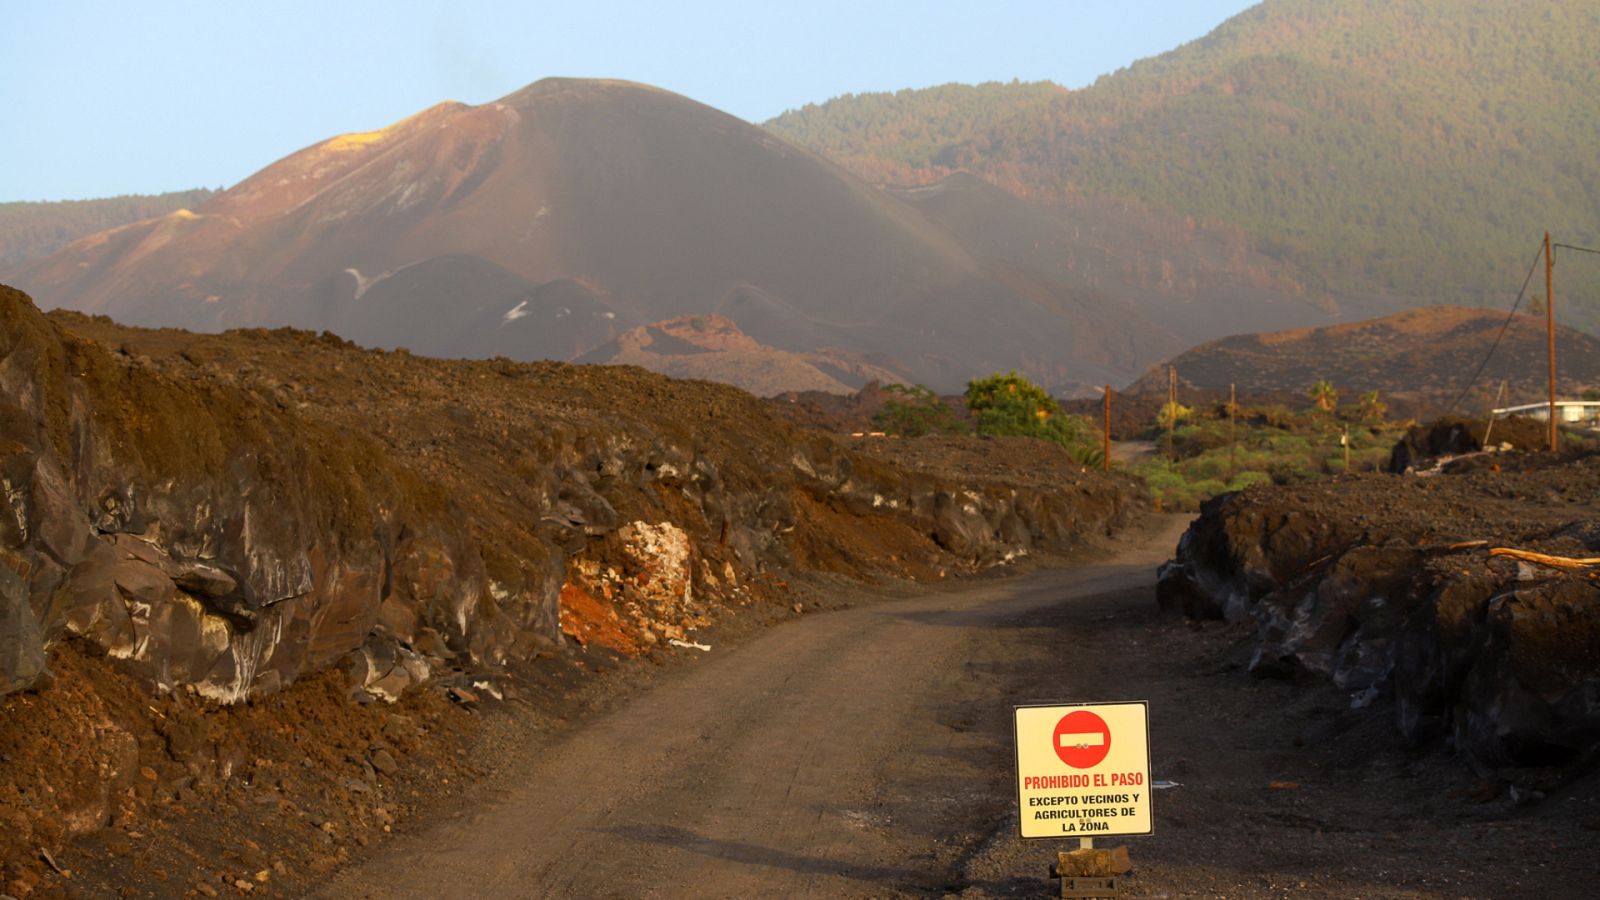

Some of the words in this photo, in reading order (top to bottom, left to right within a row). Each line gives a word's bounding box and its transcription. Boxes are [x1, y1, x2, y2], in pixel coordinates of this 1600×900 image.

[1024, 774, 1090, 789] PROHIBIDO
[1093, 773, 1108, 787] EL
[1111, 772, 1144, 786] PASO
[1029, 796, 1078, 806] EXCEPTO
[1082, 794, 1129, 804] VECINOS
[1132, 793, 1140, 802] Y
[1034, 808, 1118, 820] AGRICULTORES
[1121, 807, 1136, 816] DE
[1062, 823, 1076, 832] LA
[1080, 822, 1110, 831] ZONA
